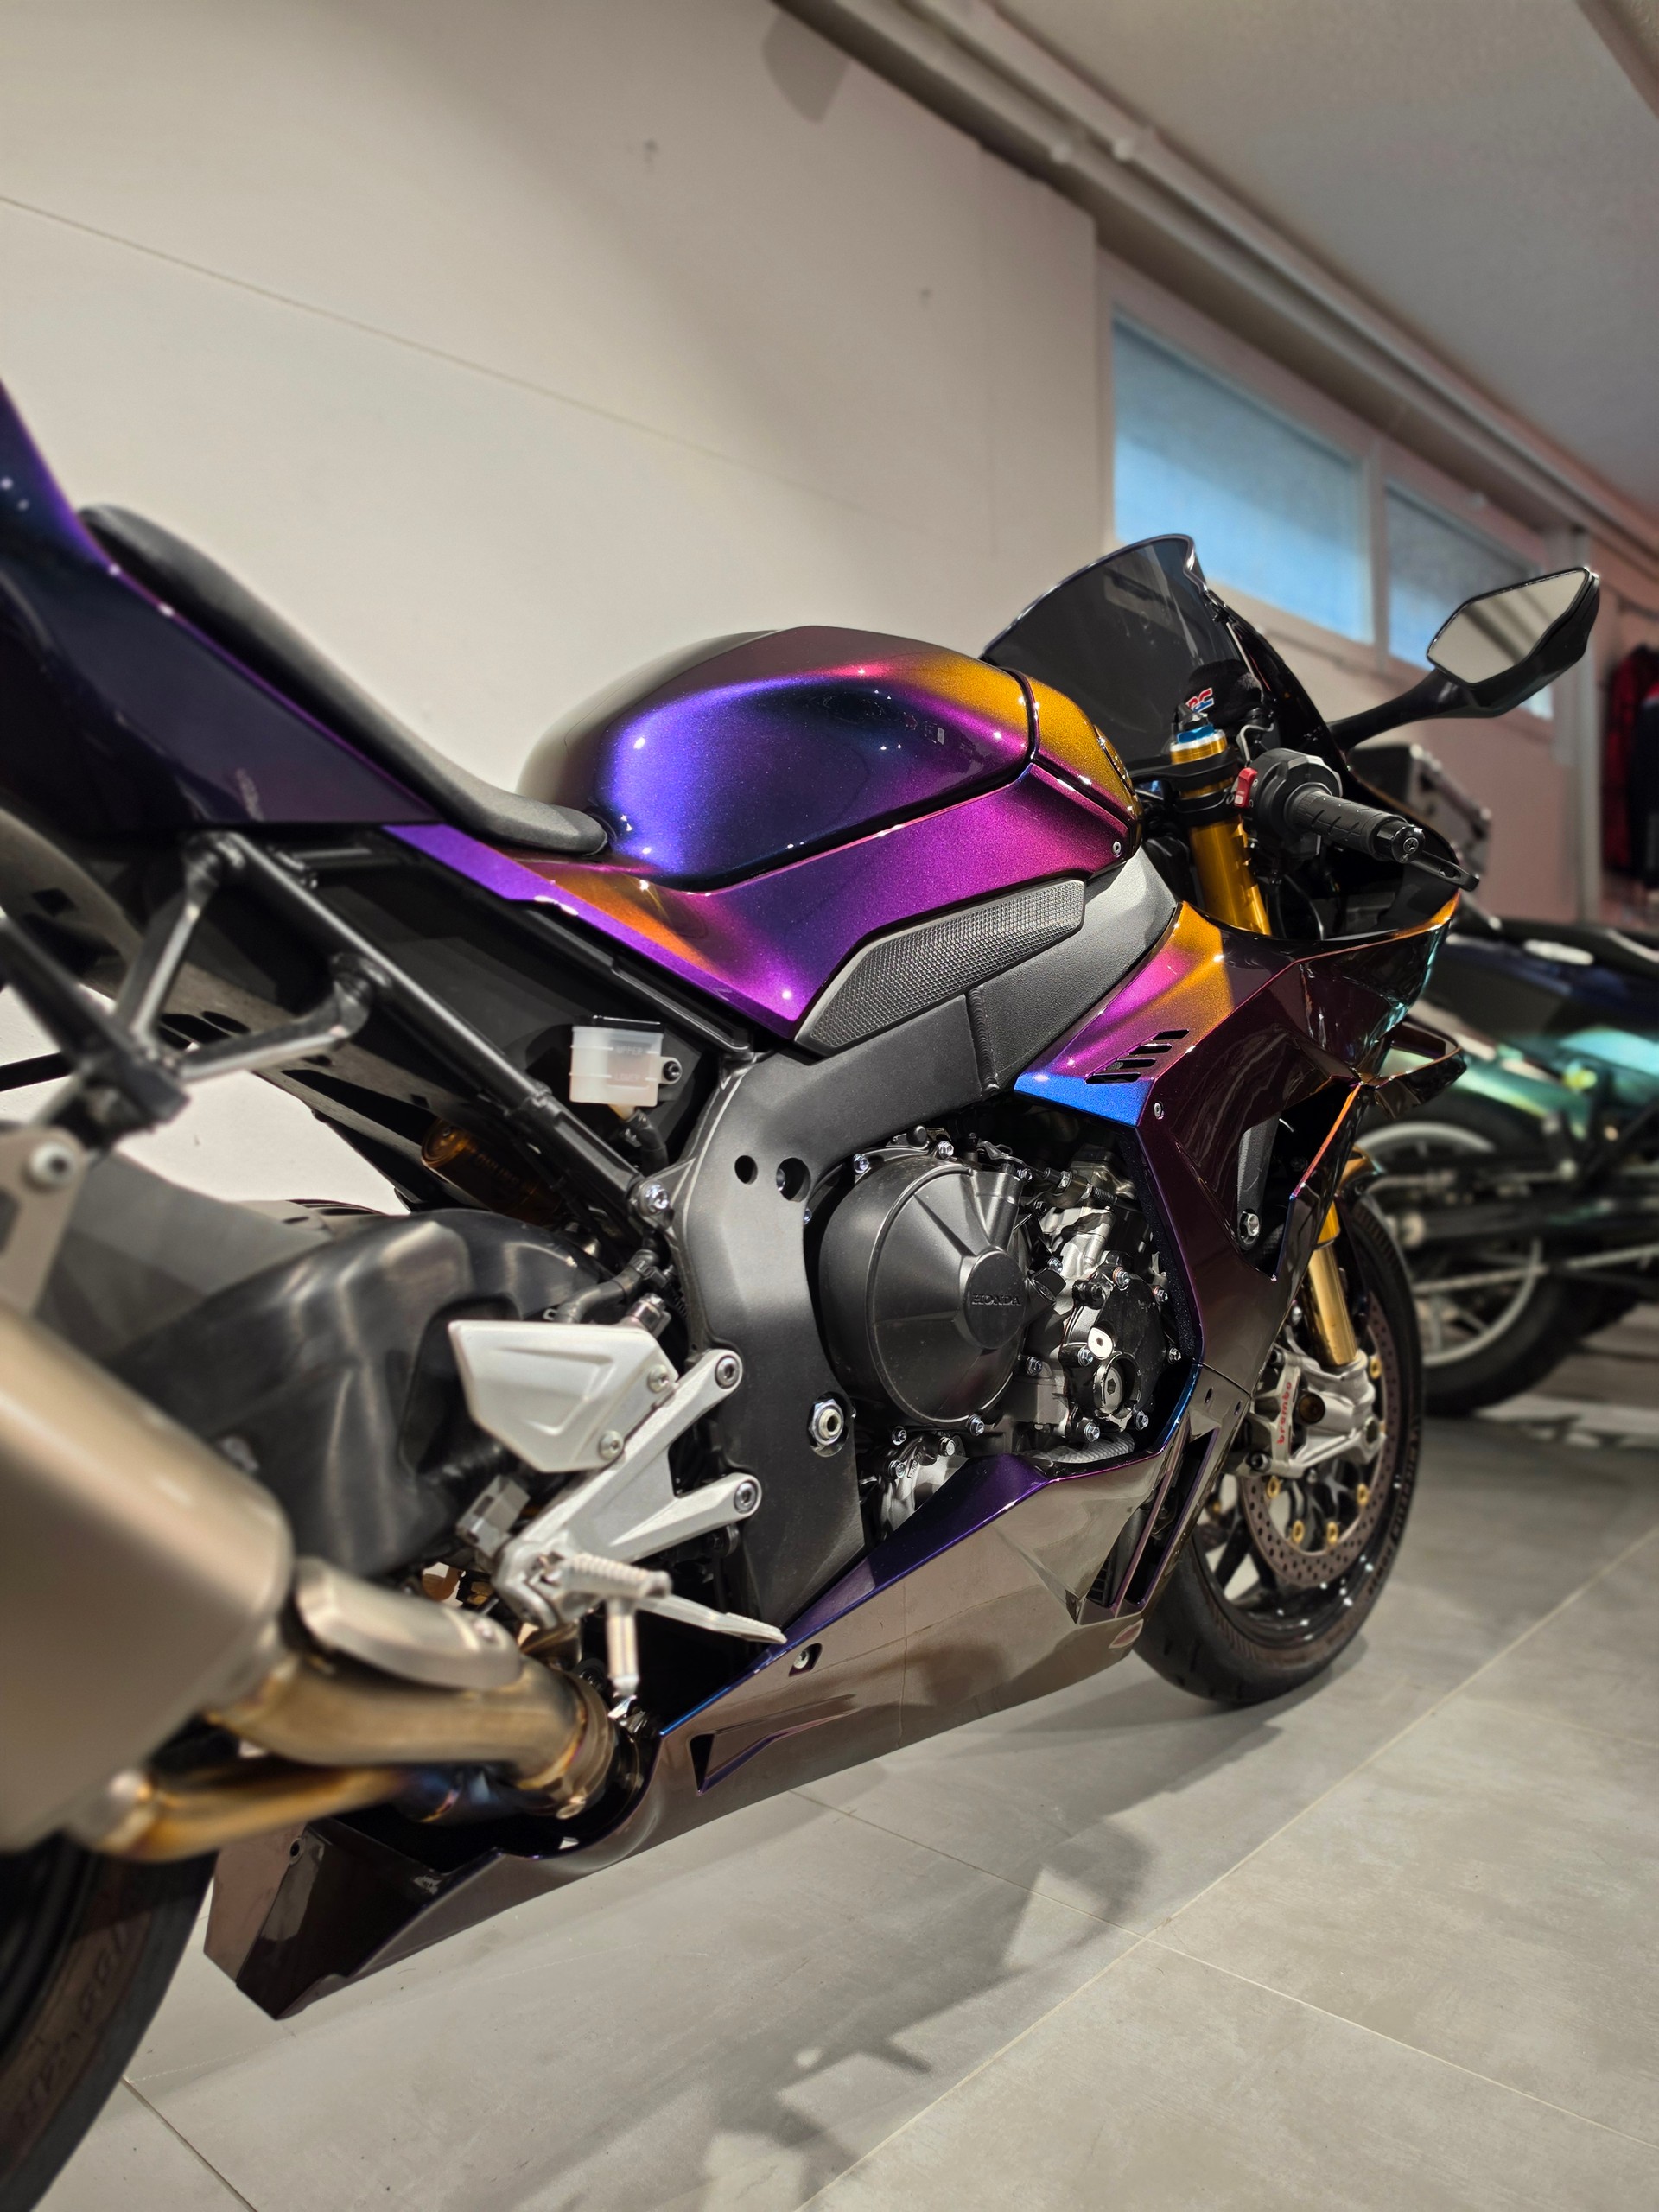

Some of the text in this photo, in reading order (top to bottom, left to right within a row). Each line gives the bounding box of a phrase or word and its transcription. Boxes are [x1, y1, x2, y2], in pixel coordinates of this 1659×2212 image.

[1185, 687, 1215, 713] RC
[616, 1046, 645, 1056] UPPER
[971, 1294, 1021, 1306] HONDA
[1277, 1382, 1293, 1445] brembo
